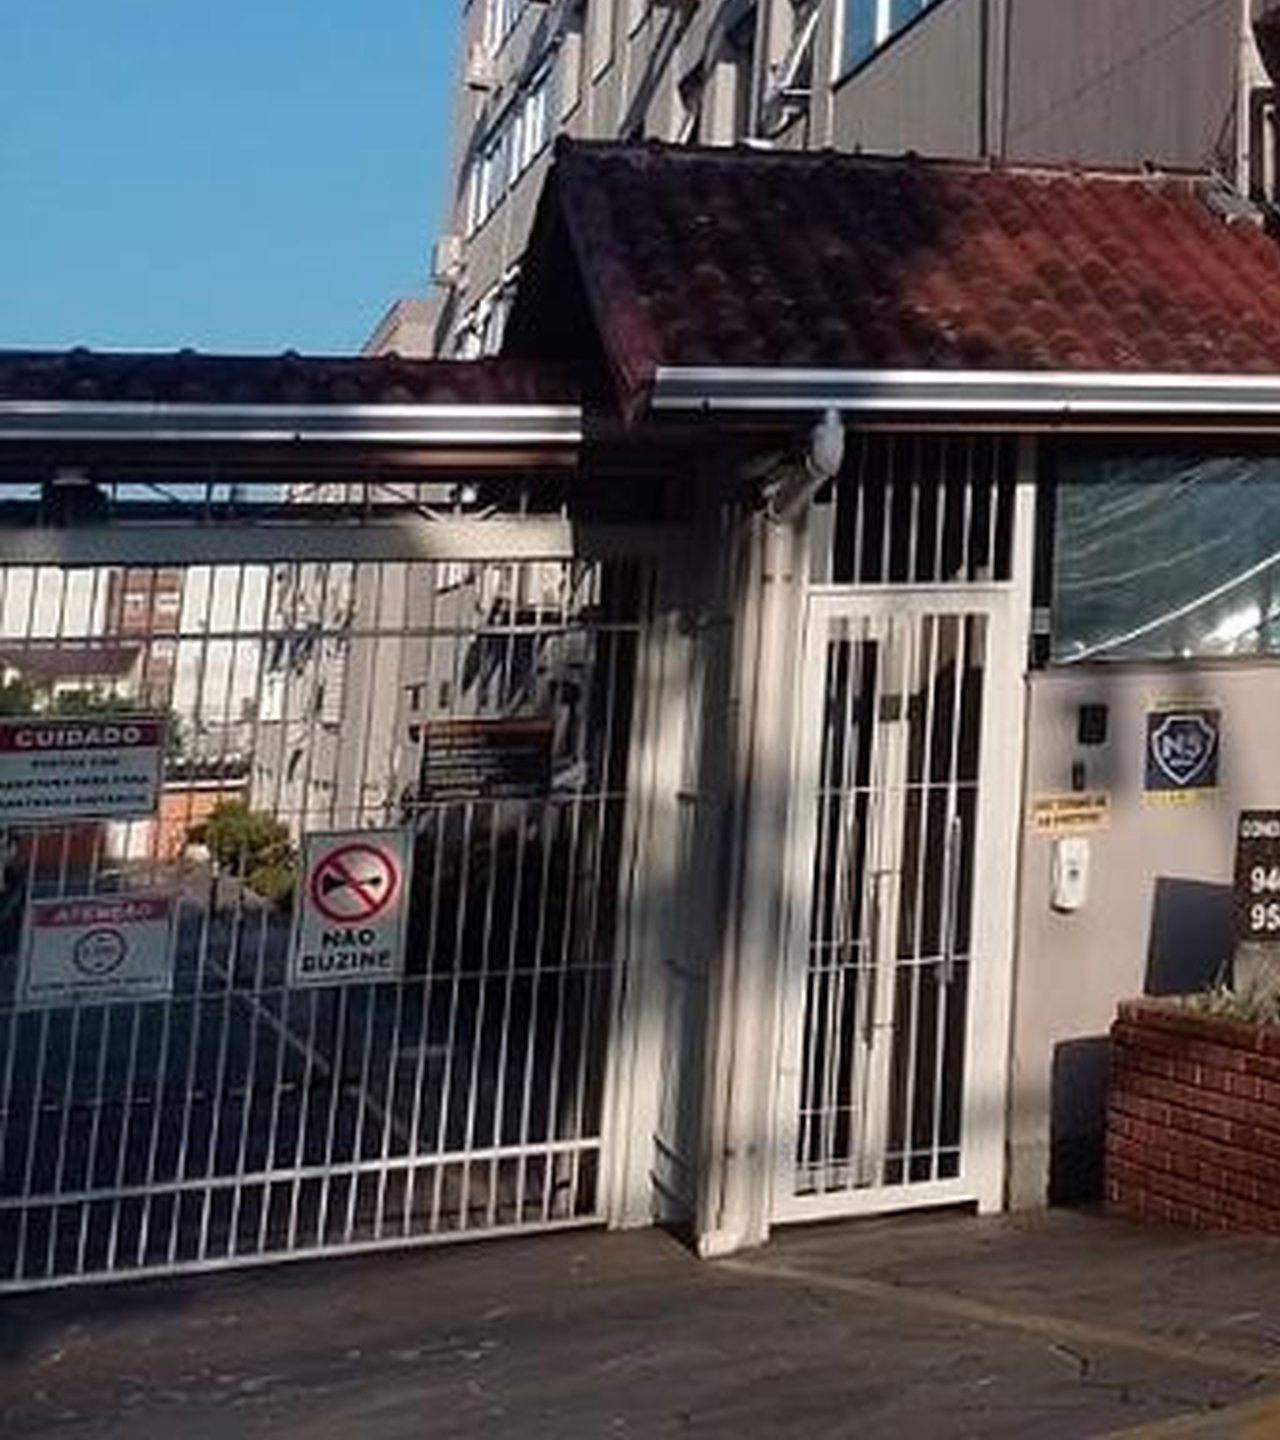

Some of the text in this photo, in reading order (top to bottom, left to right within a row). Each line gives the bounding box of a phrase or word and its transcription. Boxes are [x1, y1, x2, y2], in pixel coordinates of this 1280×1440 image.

[14, 725, 142, 748] CUIDADO
[320, 926, 376, 949] NÃO
[301, 949, 392, 973] BUZINE
